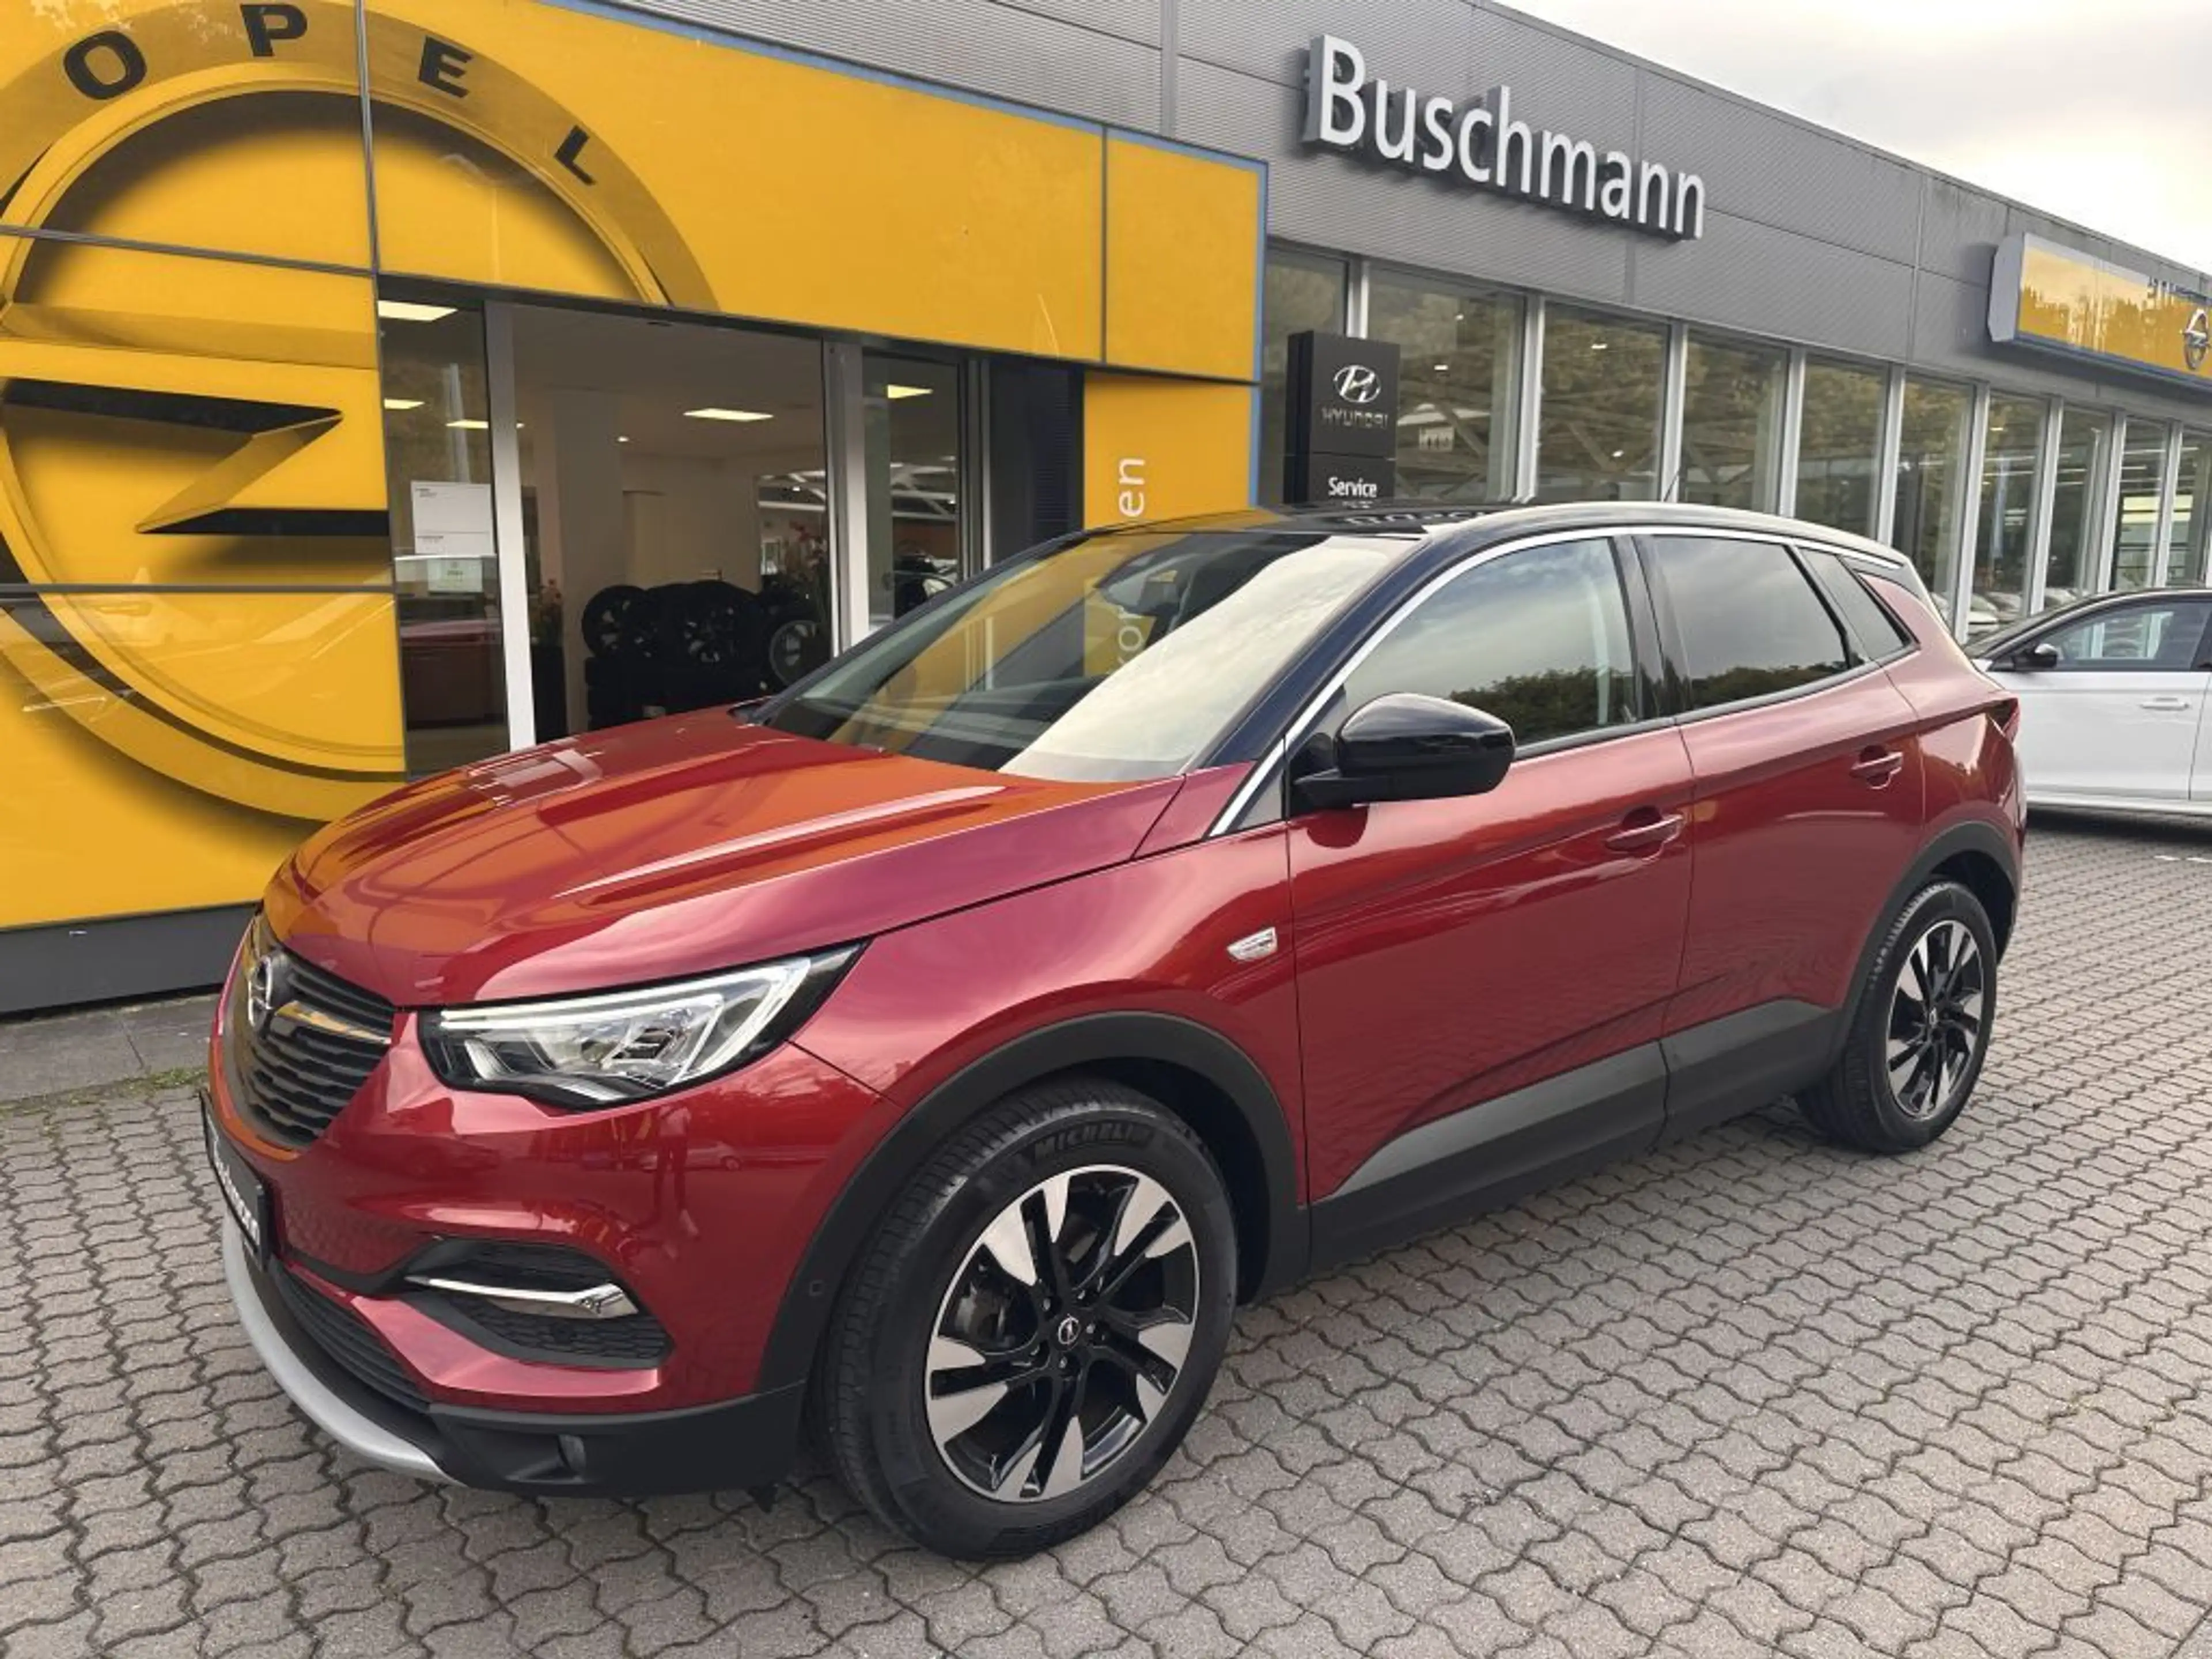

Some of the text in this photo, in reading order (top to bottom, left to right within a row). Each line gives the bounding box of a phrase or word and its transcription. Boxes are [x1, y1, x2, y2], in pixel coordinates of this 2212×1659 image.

[63, 3, 597, 186] OPEL
[1319, 33, 1705, 239] Buschmann
[1328, 477, 1377, 498] Service
